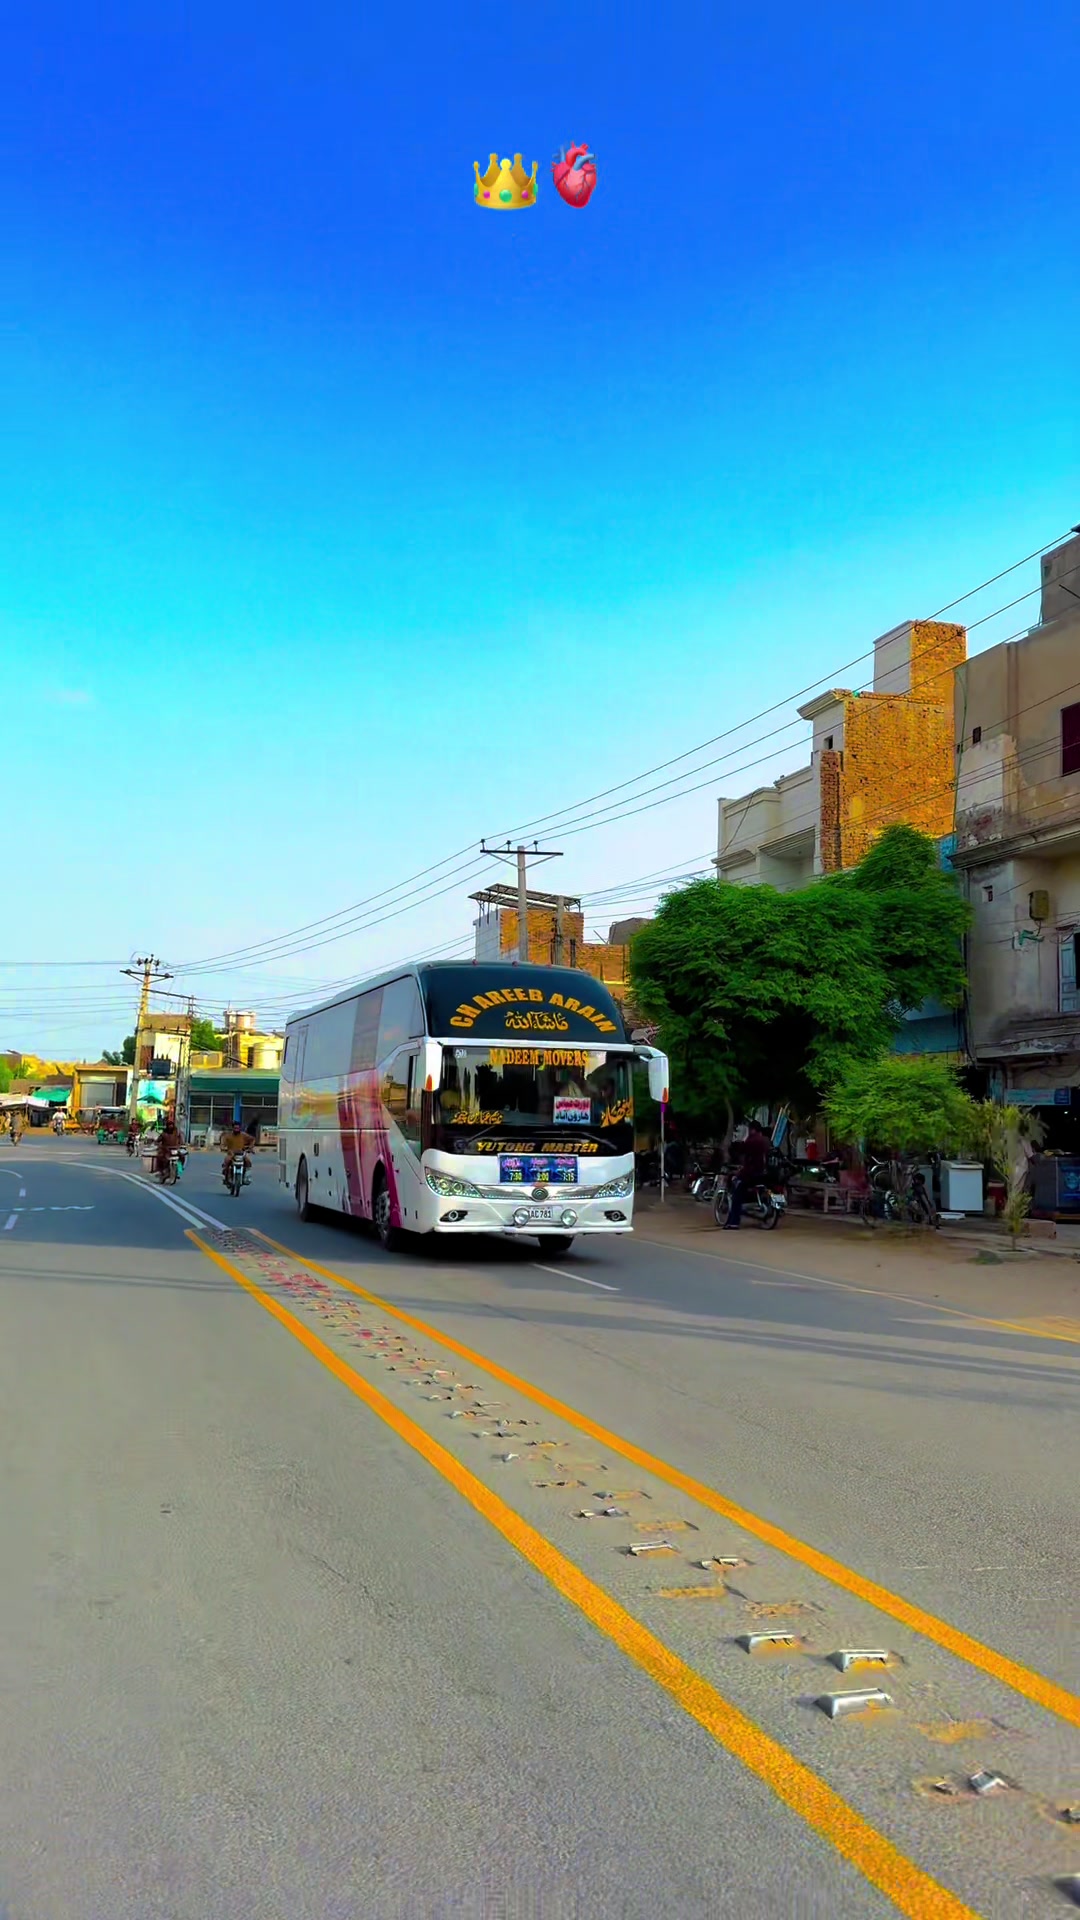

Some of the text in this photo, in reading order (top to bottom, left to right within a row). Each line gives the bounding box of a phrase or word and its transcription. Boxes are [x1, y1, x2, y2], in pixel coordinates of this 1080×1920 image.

[549, 992, 617, 1032] ARAIN
[488, 1048, 589, 1066] NADEEM MOVERS
[476, 1142, 599, 1153] YUTONG MASTER
